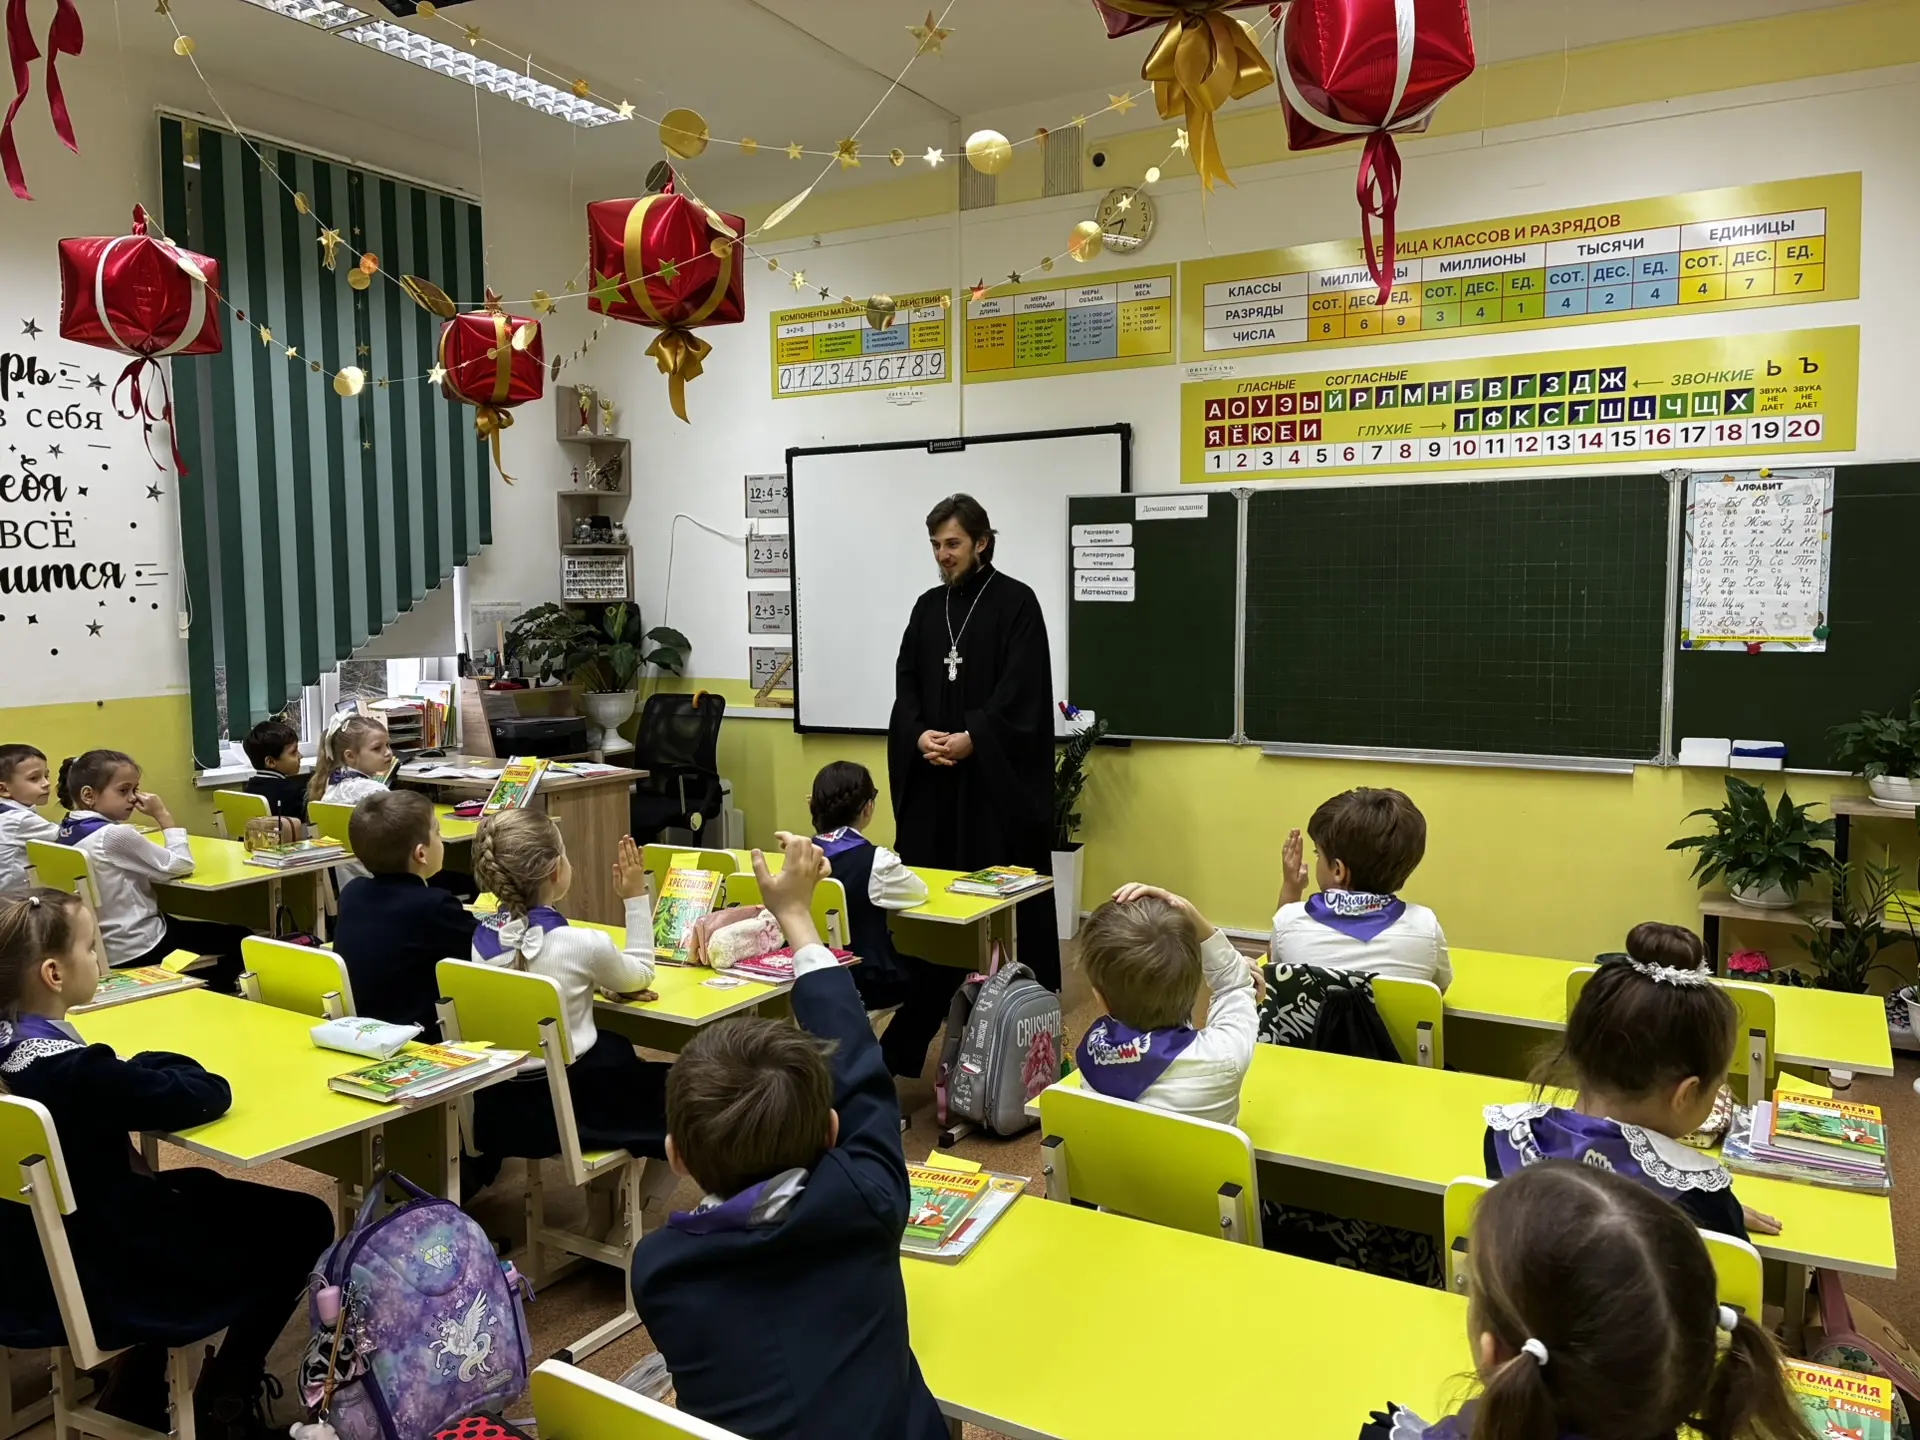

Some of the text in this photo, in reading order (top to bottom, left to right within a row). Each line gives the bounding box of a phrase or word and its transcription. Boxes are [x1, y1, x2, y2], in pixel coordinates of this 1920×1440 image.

[1357, 214, 1621, 259] ТБИЦА КЛАССОВ И РАЗРЯДОВ
[1709, 220, 1795, 242] ЕДИНИЦЫ
[1577, 238, 1645, 256] ТЫСЯЧИ
[1439, 253, 1526, 273] МИЛЛИОНЫ
[1312, 245, 1814, 310] СОТ. ДЕС ЕД. СОТ. ДЕС. ЕД. СОТ. ДЕС. ЕД. СОТ. ДЕС. ЕД.
[1321, 267, 1407, 286] МИЛЛИЫ
[1228, 282, 1281, 297] КЛАССЫ
[780, 296, 941, 322] КОМПОНЕНТЫ ДЕЙСТВИЙ
[1024, 301, 1055, 309] ПЛОЩАДИ
[1225, 305, 1284, 320] РАЗРЯДЫ
[1233, 273, 1803, 342] ЧИСЛА 8 6 9 3 4 1 4 2 4 4 7 7
[780, 353, 942, 389] 0 1 2 3 4 5 6 7 8 9
[1767, 360, 1781, 376] Ь
[1799, 357, 1818, 373] Ъ
[0, 353, 56, 401] рь
[1237, 380, 1296, 393] ГЛАСНЫЕ
[1326, 370, 1408, 386] СОГЛАСНЫЕ
[1671, 369, 1754, 386] ЗВОНКИЕ
[1209, 372, 1624, 417] А О У Э Ы Й Р Л М Н Б В Г З Д Ж
[27, 403, 103, 430] себя
[1460, 393, 1748, 429] П Ф К С Т Ш Ц Ч Щ Х
[1209, 424, 1317, 444] Я Ё Ю Е И
[1358, 423, 1412, 436] ГЛУХИЕ
[1214, 420, 1820, 469] 1 2 3 4 5 6 7 8 9 10 11 12 13 14 15 16 17 18 19 20
[0, 454, 67, 502] ебя
[1736, 482, 1783, 492] АЛФАВИТ
[1081, 575, 1110, 583] Русский
[1784, 1095, 1875, 1115] ХРЕСТОМАТИЯ
[1834, 1399, 1880, 1418] 1 КЛАСС
